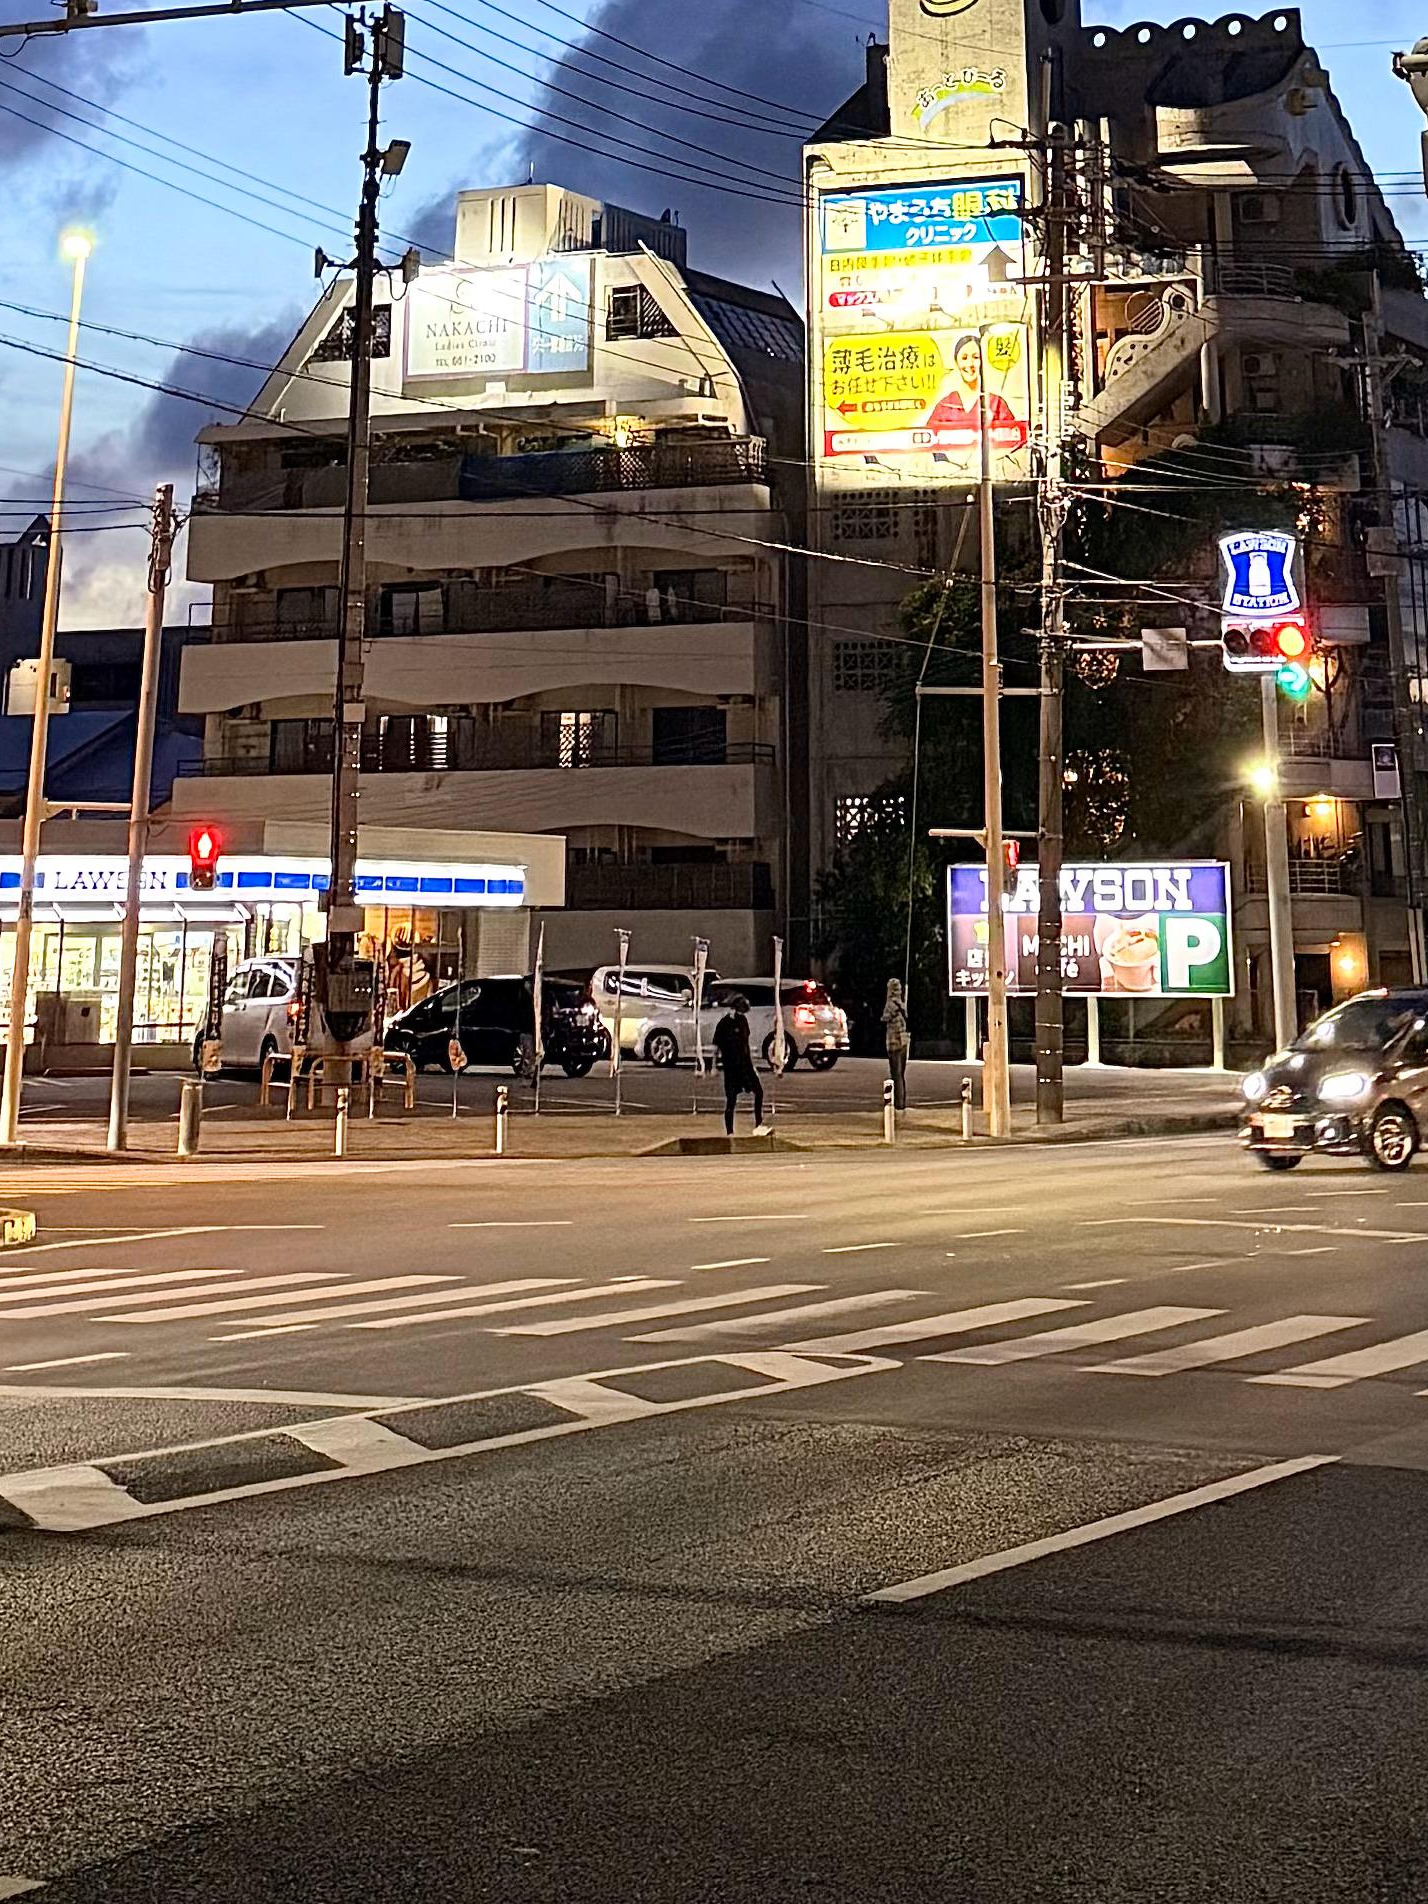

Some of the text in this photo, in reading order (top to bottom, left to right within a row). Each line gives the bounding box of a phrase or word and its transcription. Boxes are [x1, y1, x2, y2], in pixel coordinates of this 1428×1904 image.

[906, 222, 977, 245] クリニック
[426, 317, 508, 339] NAKACHI
[832, 345, 936, 374] 薄毛治療は
[1228, 538, 1288, 555] LAWSON
[1231, 591, 1290, 608] STATION
[1022, 934, 1090, 957] MCHI
[1165, 917, 1221, 988] P
[956, 968, 1014, 988] キッン
